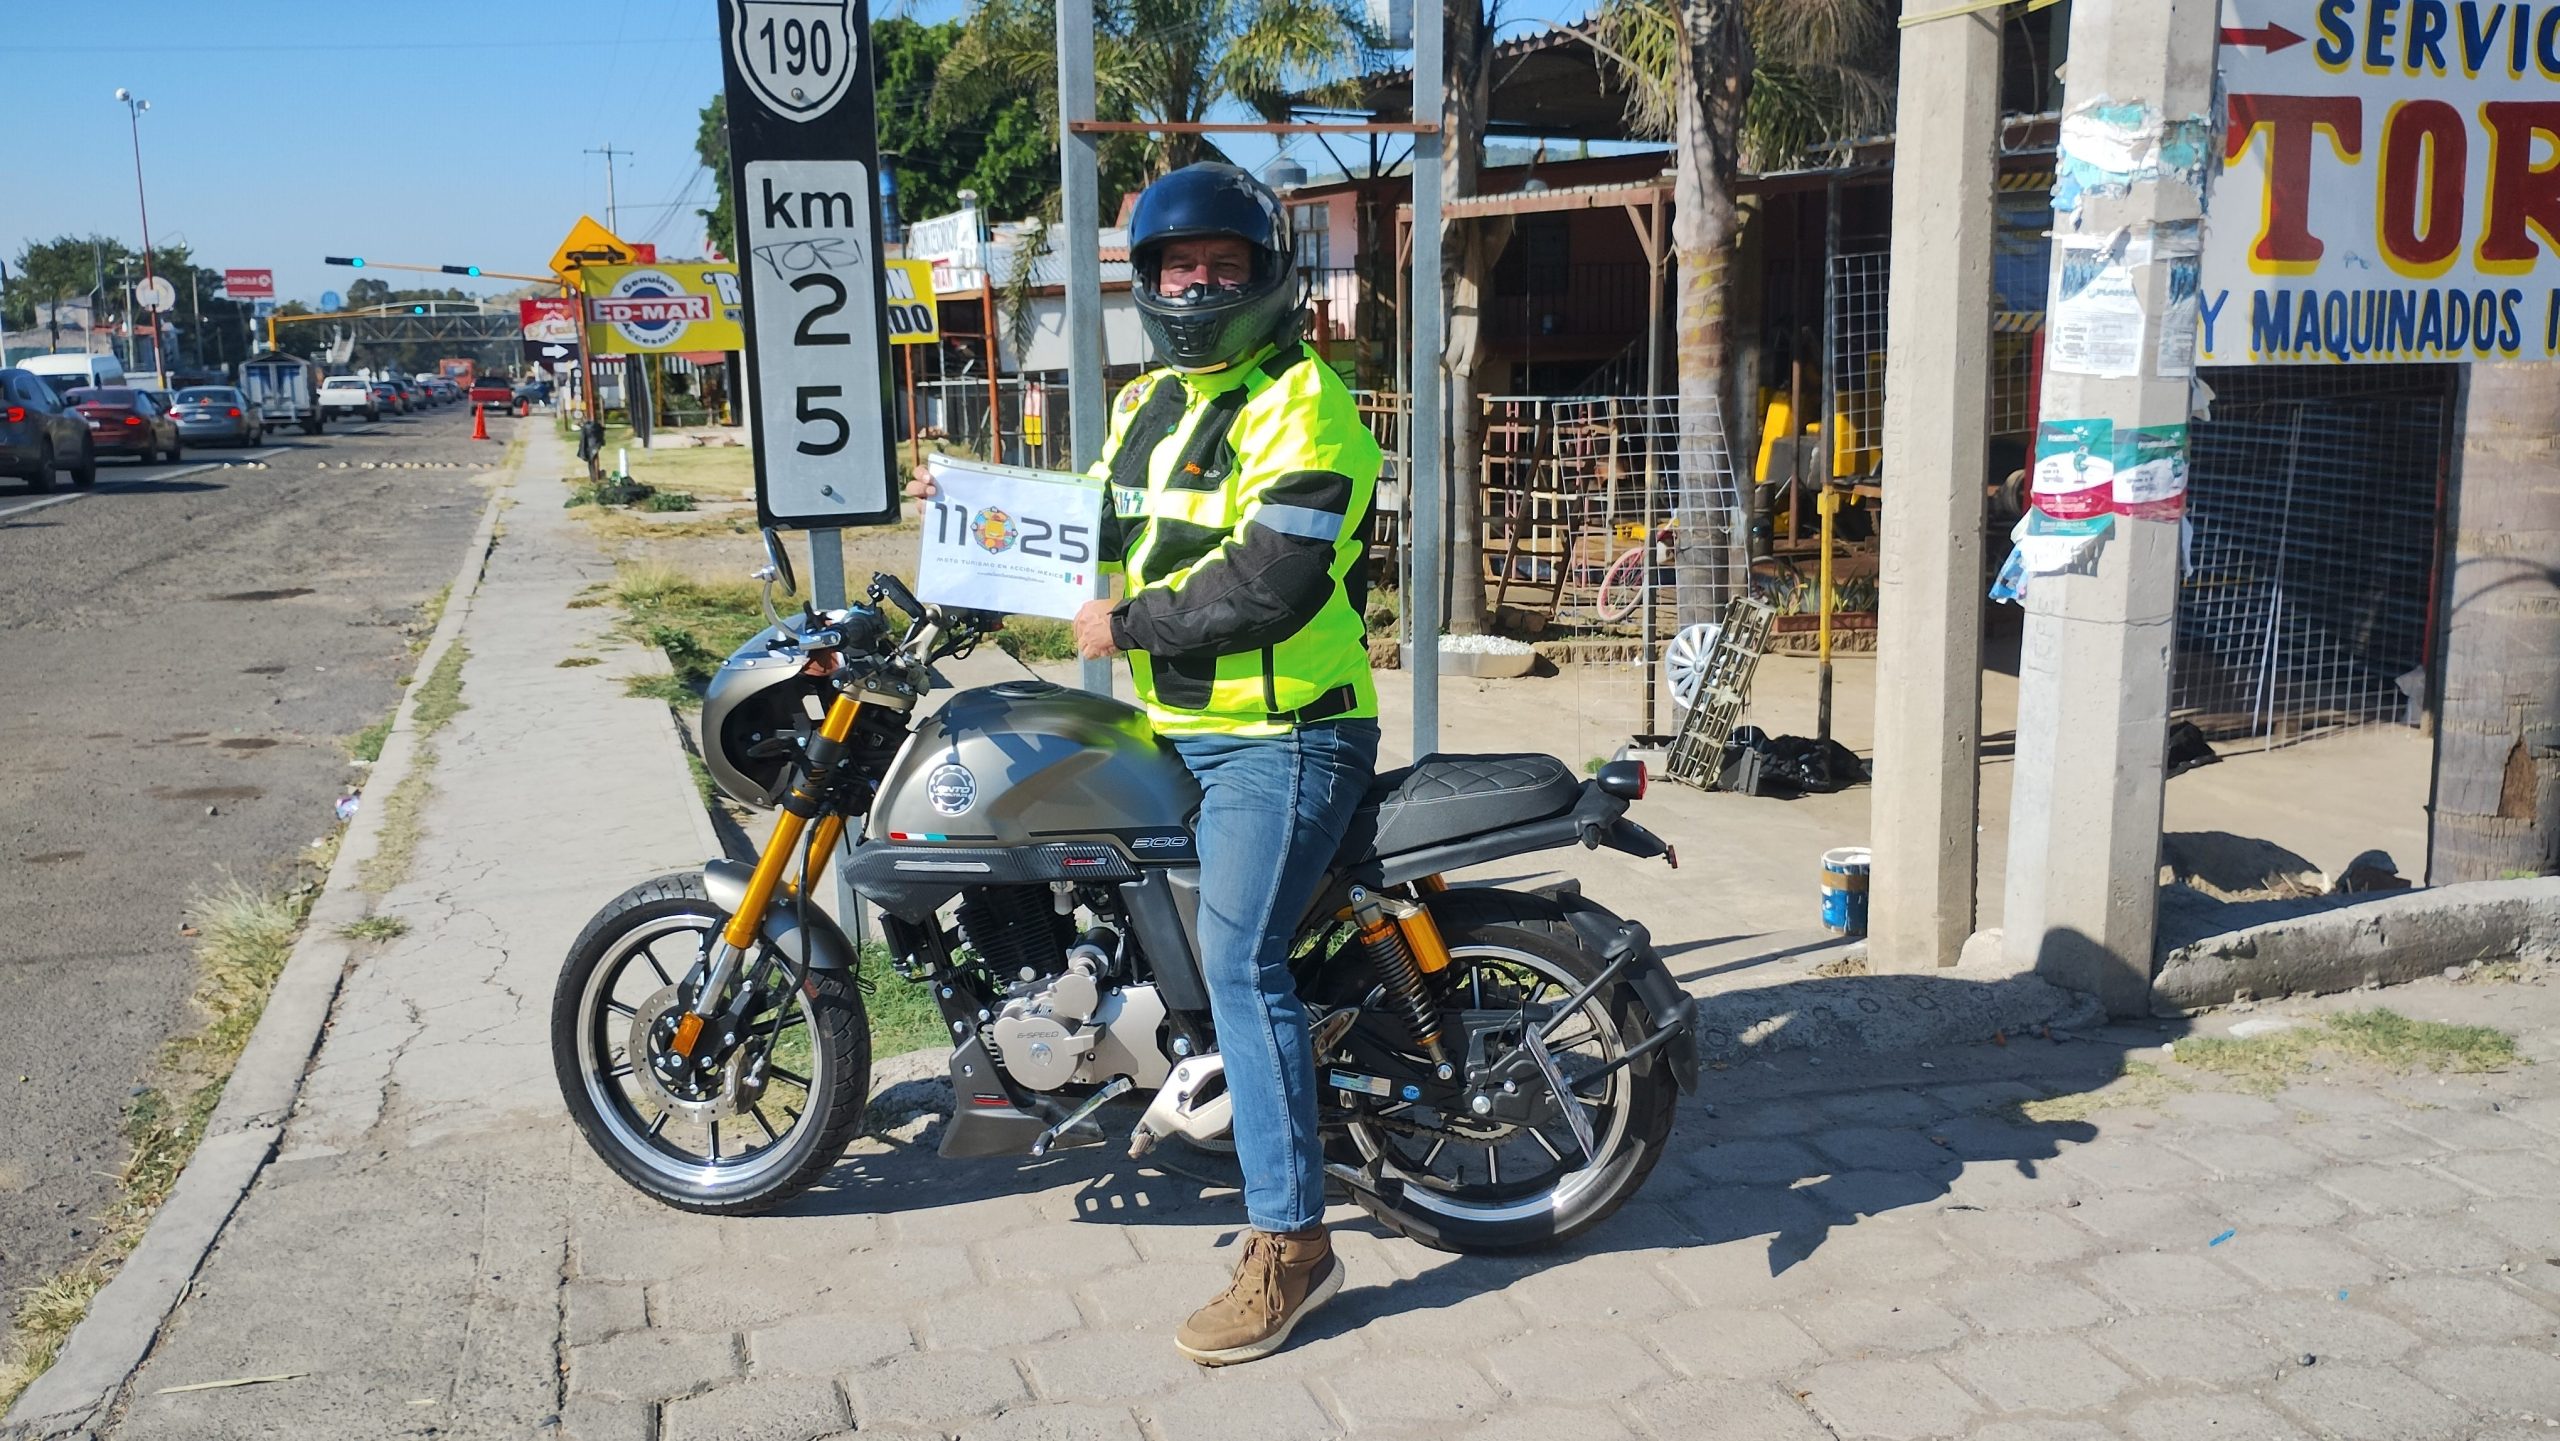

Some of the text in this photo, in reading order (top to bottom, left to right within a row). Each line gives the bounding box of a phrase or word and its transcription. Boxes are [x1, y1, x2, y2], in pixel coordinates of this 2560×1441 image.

[760, 18, 832, 76] 190
[762, 178, 854, 229] km
[2224, 94, 2560, 278] TOR
[594, 297, 706, 321] ED-MAR
[789, 272, 852, 346] 2
[2198, 289, 2230, 354] Y
[2250, 288, 2524, 362] MAQUINADOS
[796, 385, 851, 456] 5
[961, 559, 996, 568] TURISMO
[1131, 836, 1189, 849] 300
[1016, 1030, 1060, 1039] 6-SPEED
